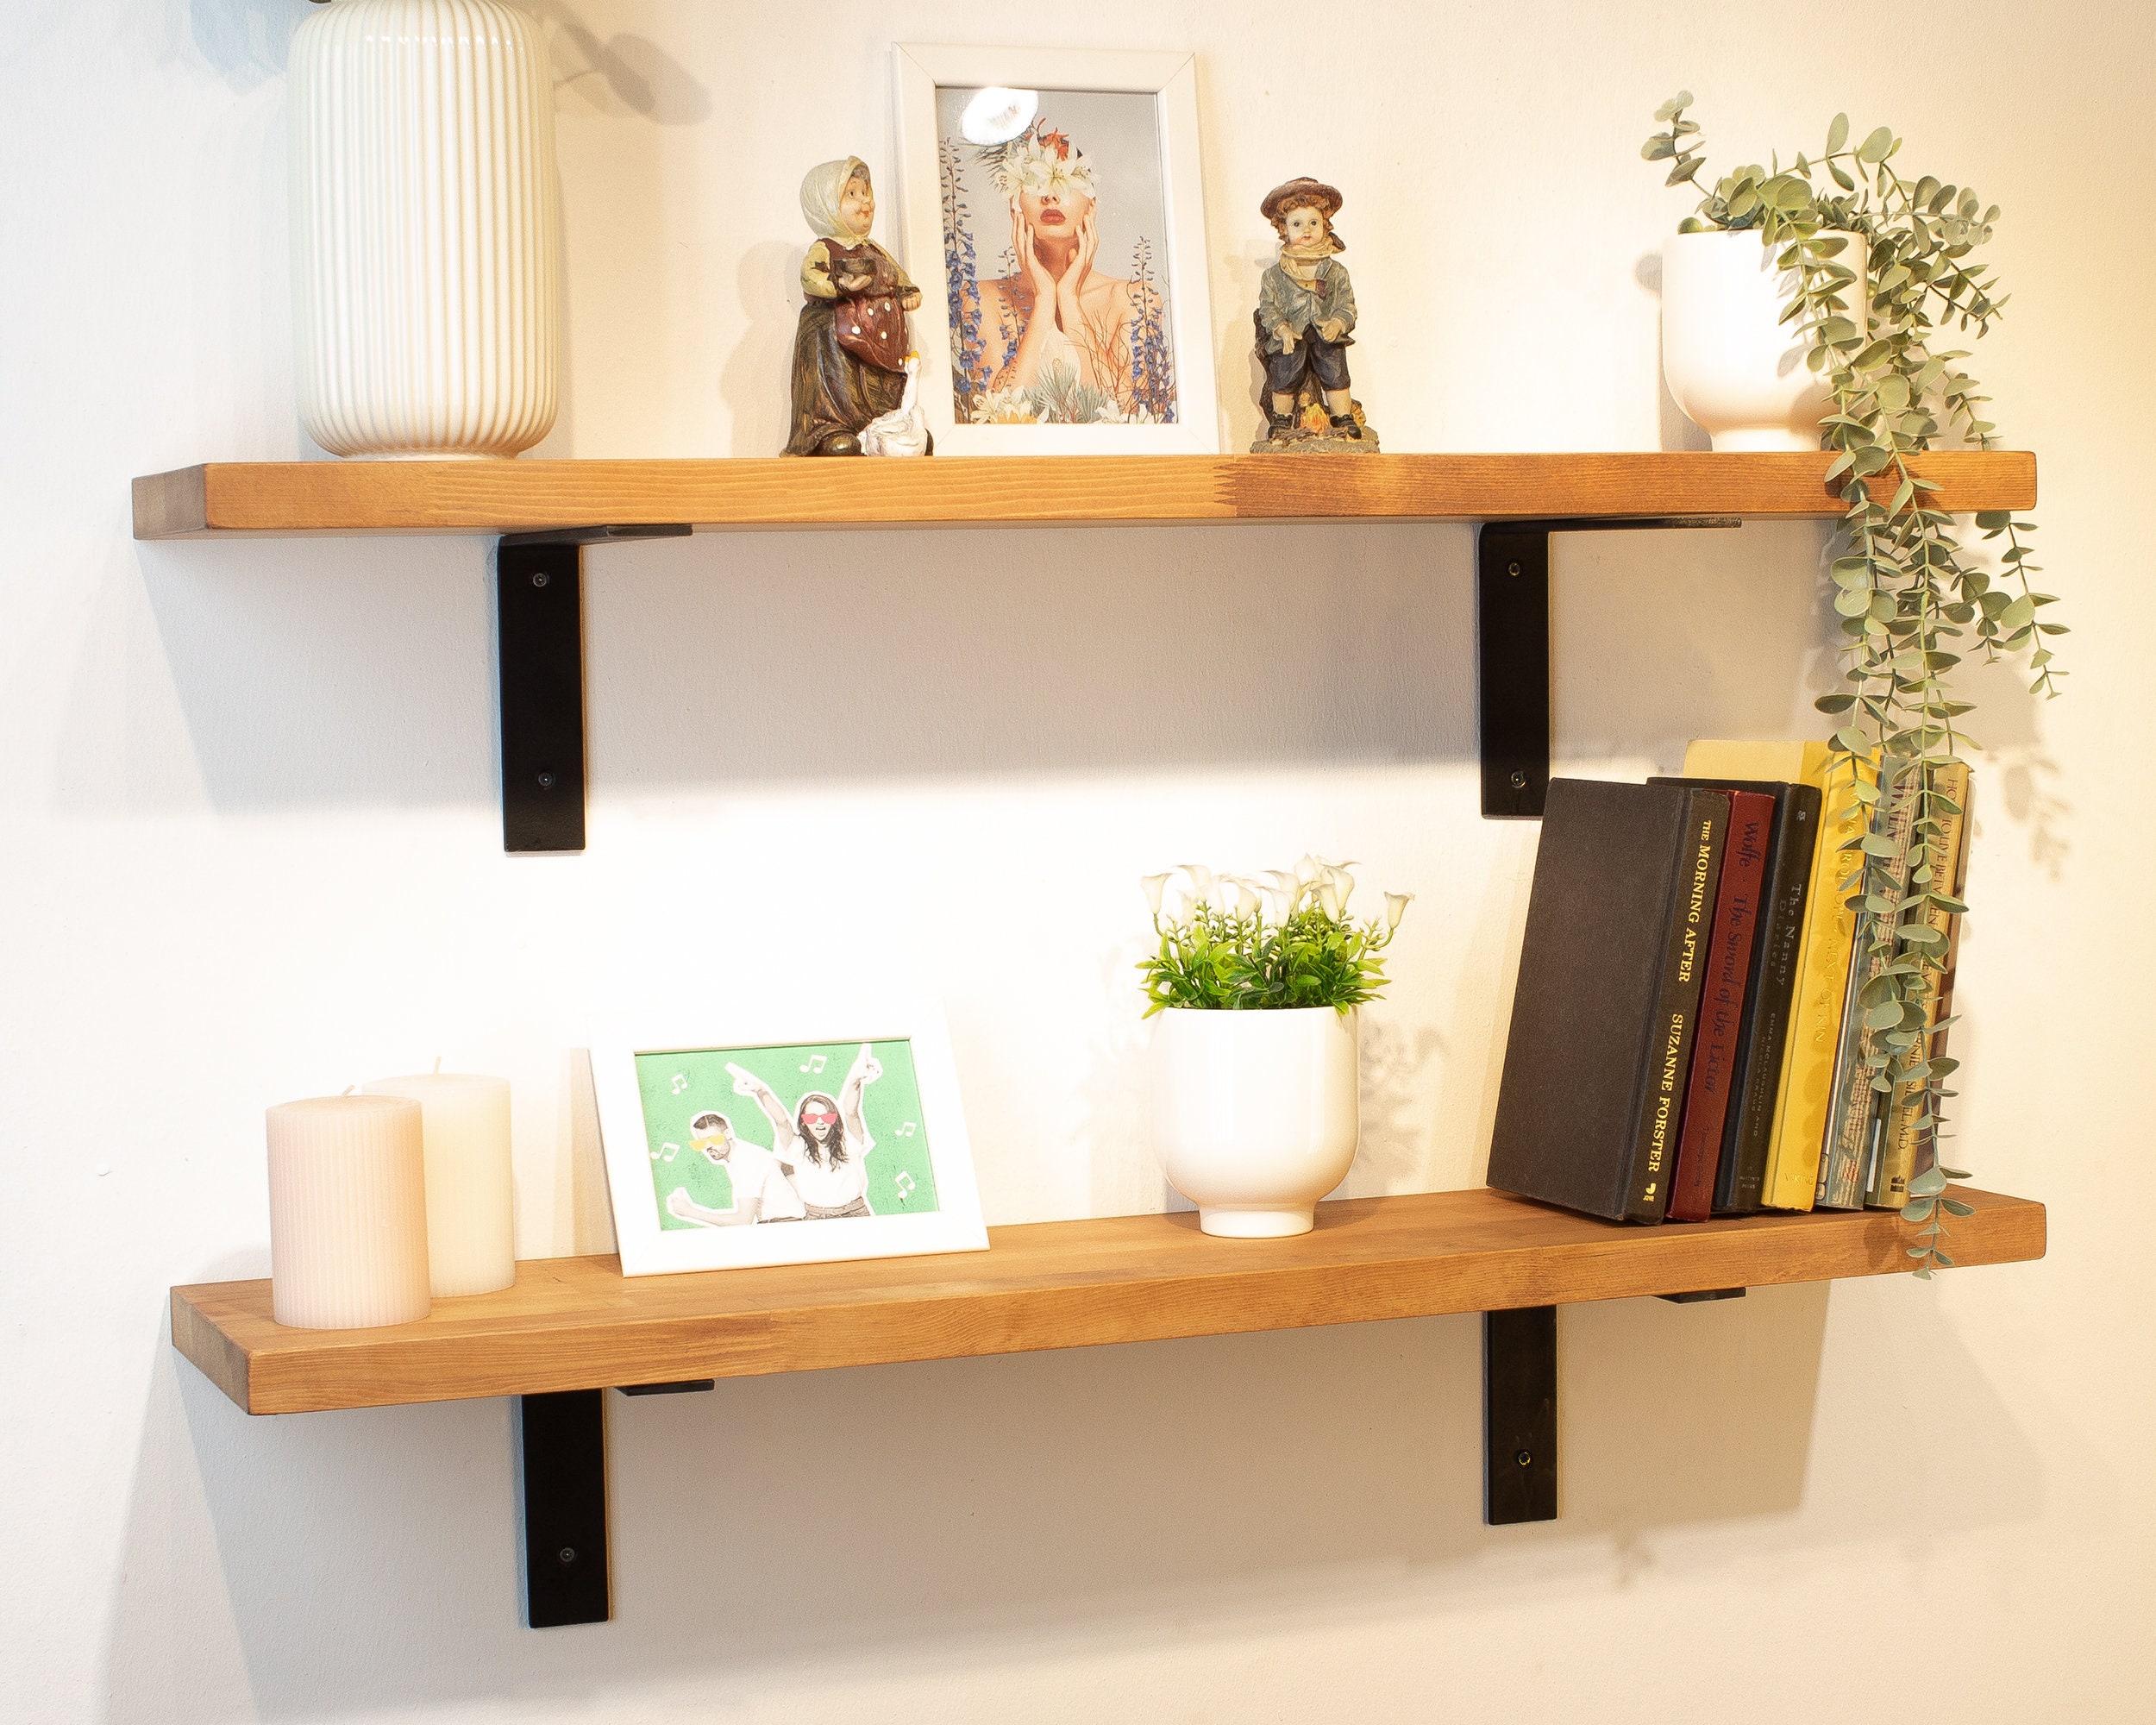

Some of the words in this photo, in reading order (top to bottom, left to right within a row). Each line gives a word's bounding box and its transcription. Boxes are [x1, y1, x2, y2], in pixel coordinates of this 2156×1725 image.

[1946, 778, 1958, 802] HO
[1701, 819, 1712, 841] THE
[1735, 821, 1761, 868] Wolfe
[1940, 817, 1953, 834] TO
[1688, 844, 1711, 924] MORNING
[1788, 883, 1802, 916] The
[1928, 864, 1946, 925] BETEN
[1728, 894, 1752, 927] The
[1678, 927, 1697, 982] AFTER
[1771, 900, 1787, 967] Diaries
[1777, 925, 1796, 986] Nanny
[1722, 932, 1742, 988] Sword
[1714, 988, 1739, 1009] of
[1711, 1011, 1735, 1037] the
[1767, 1013, 1776, 1041] EMMA
[1661, 1013, 1684, 1091] SUZANNE
[1704, 1044, 1726, 1095] Lictor
[1900, 1081, 1917, 1122] SIEL,
[1648, 1096, 1670, 1172] FORSTER
[1897, 1124, 1910, 1151] M.D.
